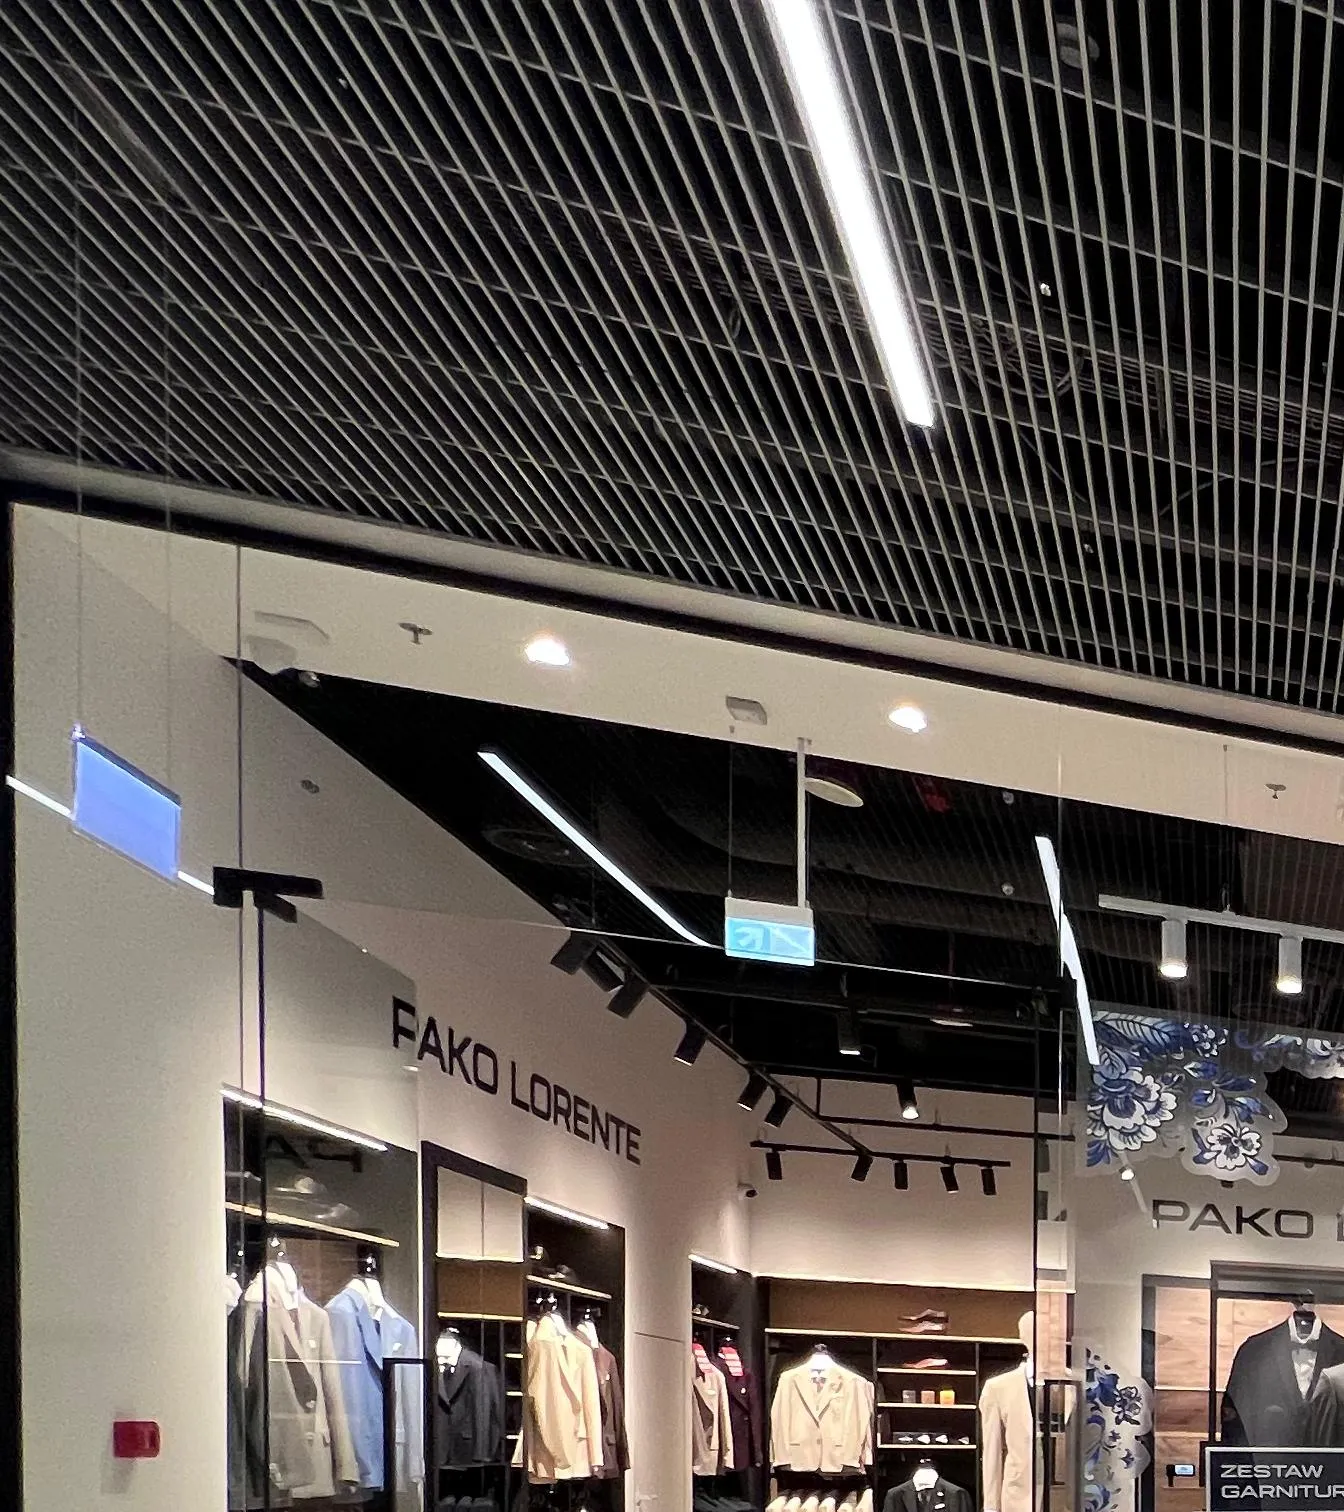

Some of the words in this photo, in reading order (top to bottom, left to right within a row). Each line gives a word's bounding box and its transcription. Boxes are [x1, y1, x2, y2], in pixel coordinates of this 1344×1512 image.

[391, 995, 499, 1096] PAKO
[510, 1060, 642, 1166] LORENTE
[1152, 1199, 1315, 1239] PAKO
[1220, 1464, 1324, 1479] ZESTAW
